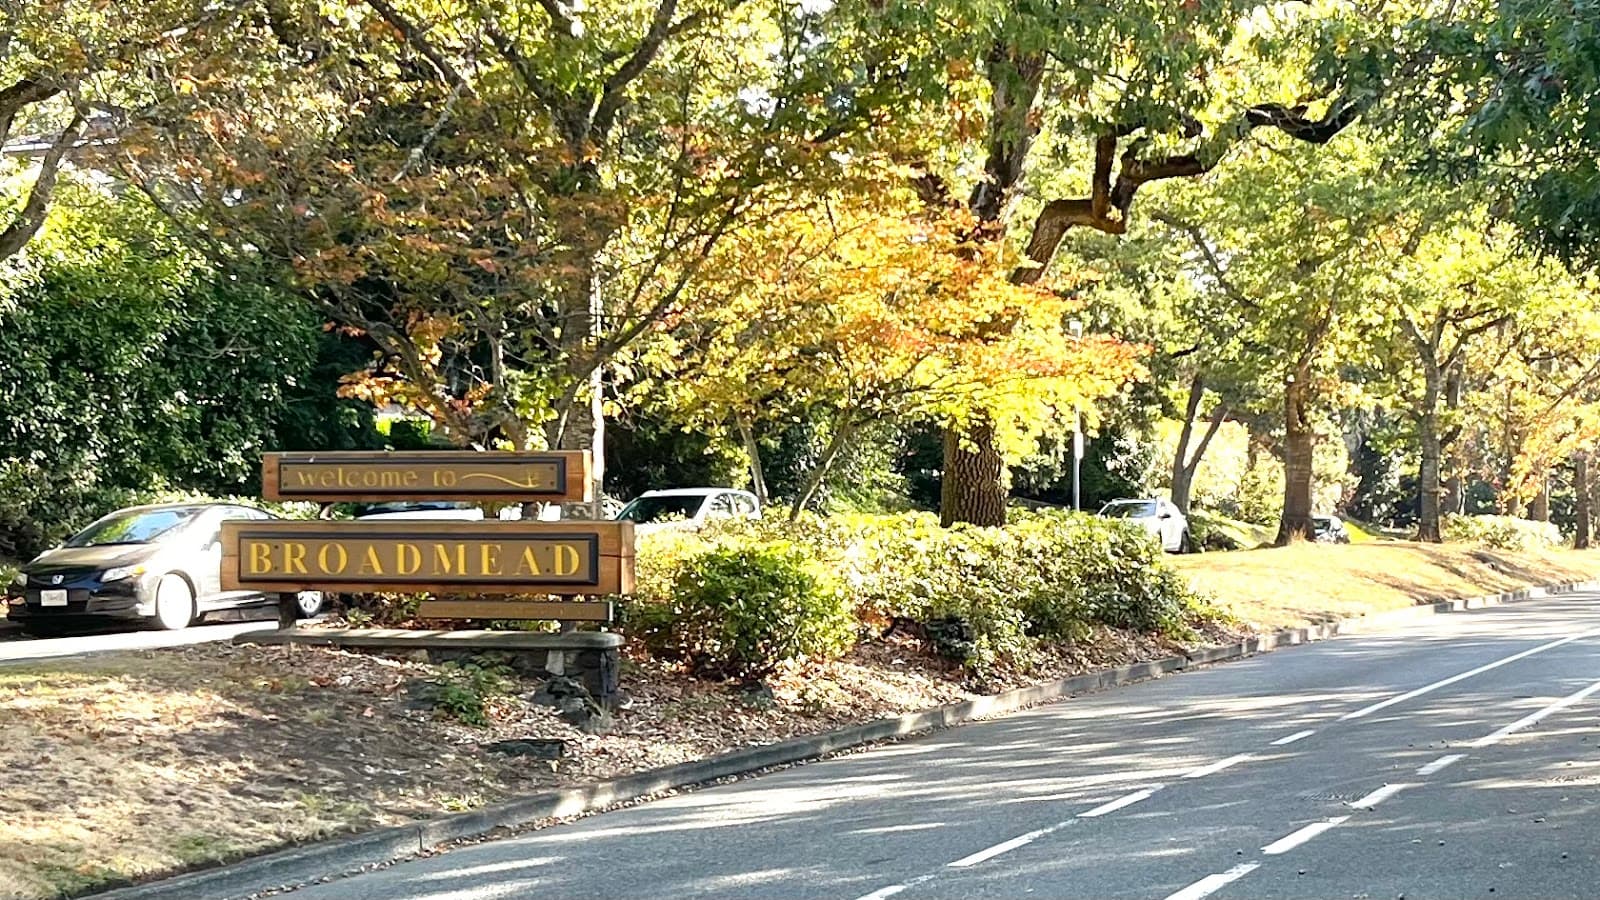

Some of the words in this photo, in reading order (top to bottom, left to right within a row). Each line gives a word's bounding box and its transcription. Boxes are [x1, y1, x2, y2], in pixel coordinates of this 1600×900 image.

[298, 468, 418, 487] welcome
[433, 469, 458, 488] to
[249, 543, 581, 576] BROADMEAD
